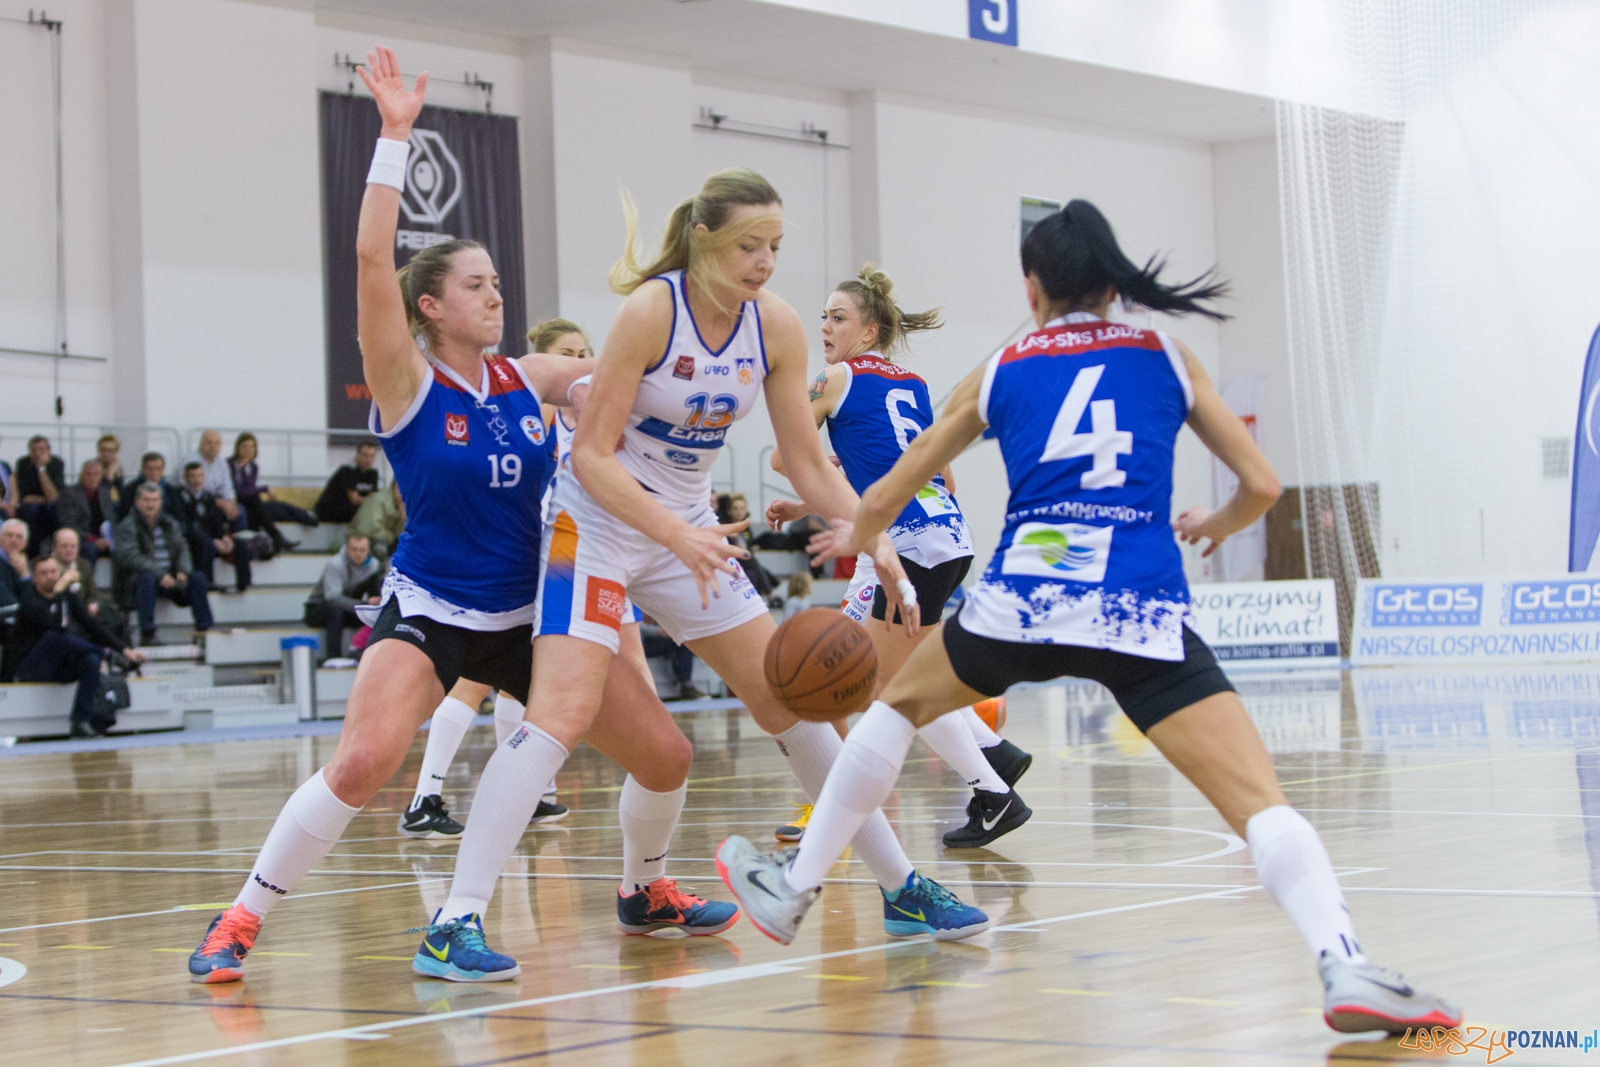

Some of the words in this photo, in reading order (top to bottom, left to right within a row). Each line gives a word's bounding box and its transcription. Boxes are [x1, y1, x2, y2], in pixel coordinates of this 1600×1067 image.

[684, 391, 739, 429] 13
[885, 388, 924, 453] 6
[1038, 364, 1133, 490] 4
[667, 426, 725, 442] Enea
[487, 453, 522, 488] 19
[1217, 615, 1323, 639] klimat!
